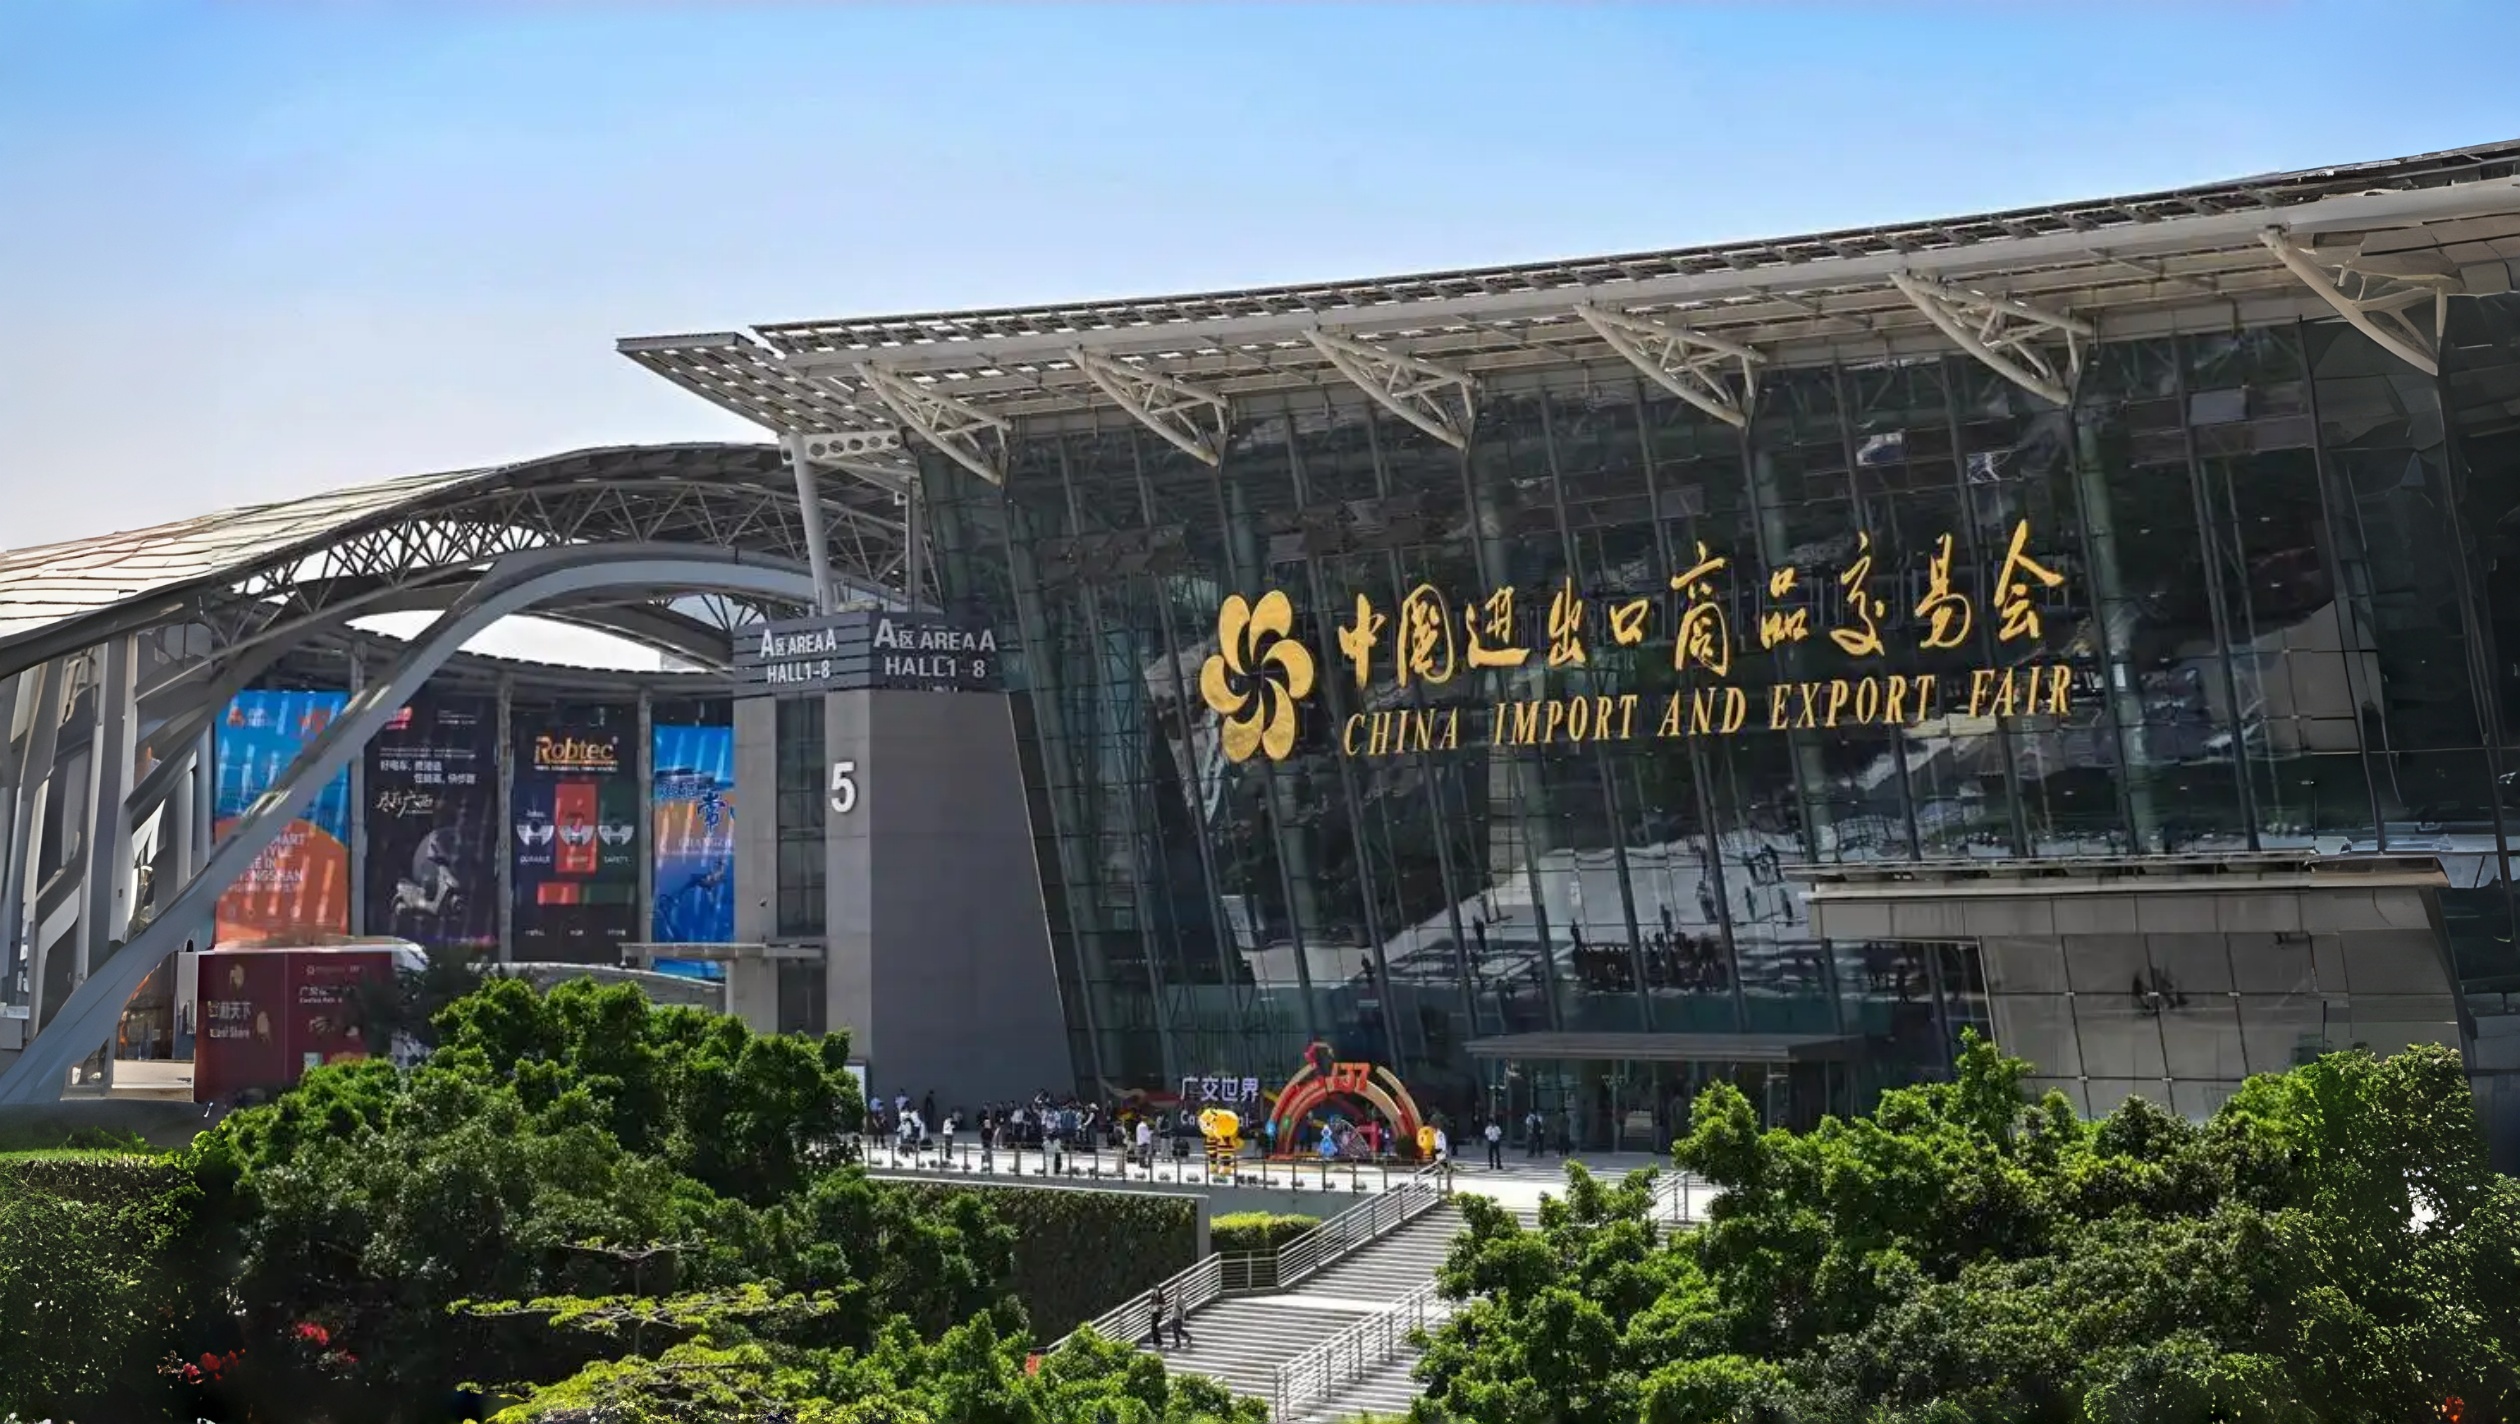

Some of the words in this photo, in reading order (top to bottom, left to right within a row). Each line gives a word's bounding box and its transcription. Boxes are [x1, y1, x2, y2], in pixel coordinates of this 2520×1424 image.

[1344, 706, 1460, 758] CHINA
[1494, 694, 1639, 747] IMPORT
[1657, 686, 1748, 738] AND
[1769, 674, 1936, 731] EXPORT
[1967, 663, 2073, 719] FAIR
[534, 736, 614, 764] Robtec
[830, 760, 857, 813] 5
[1180, 1074, 1260, 1103] 广交世界
